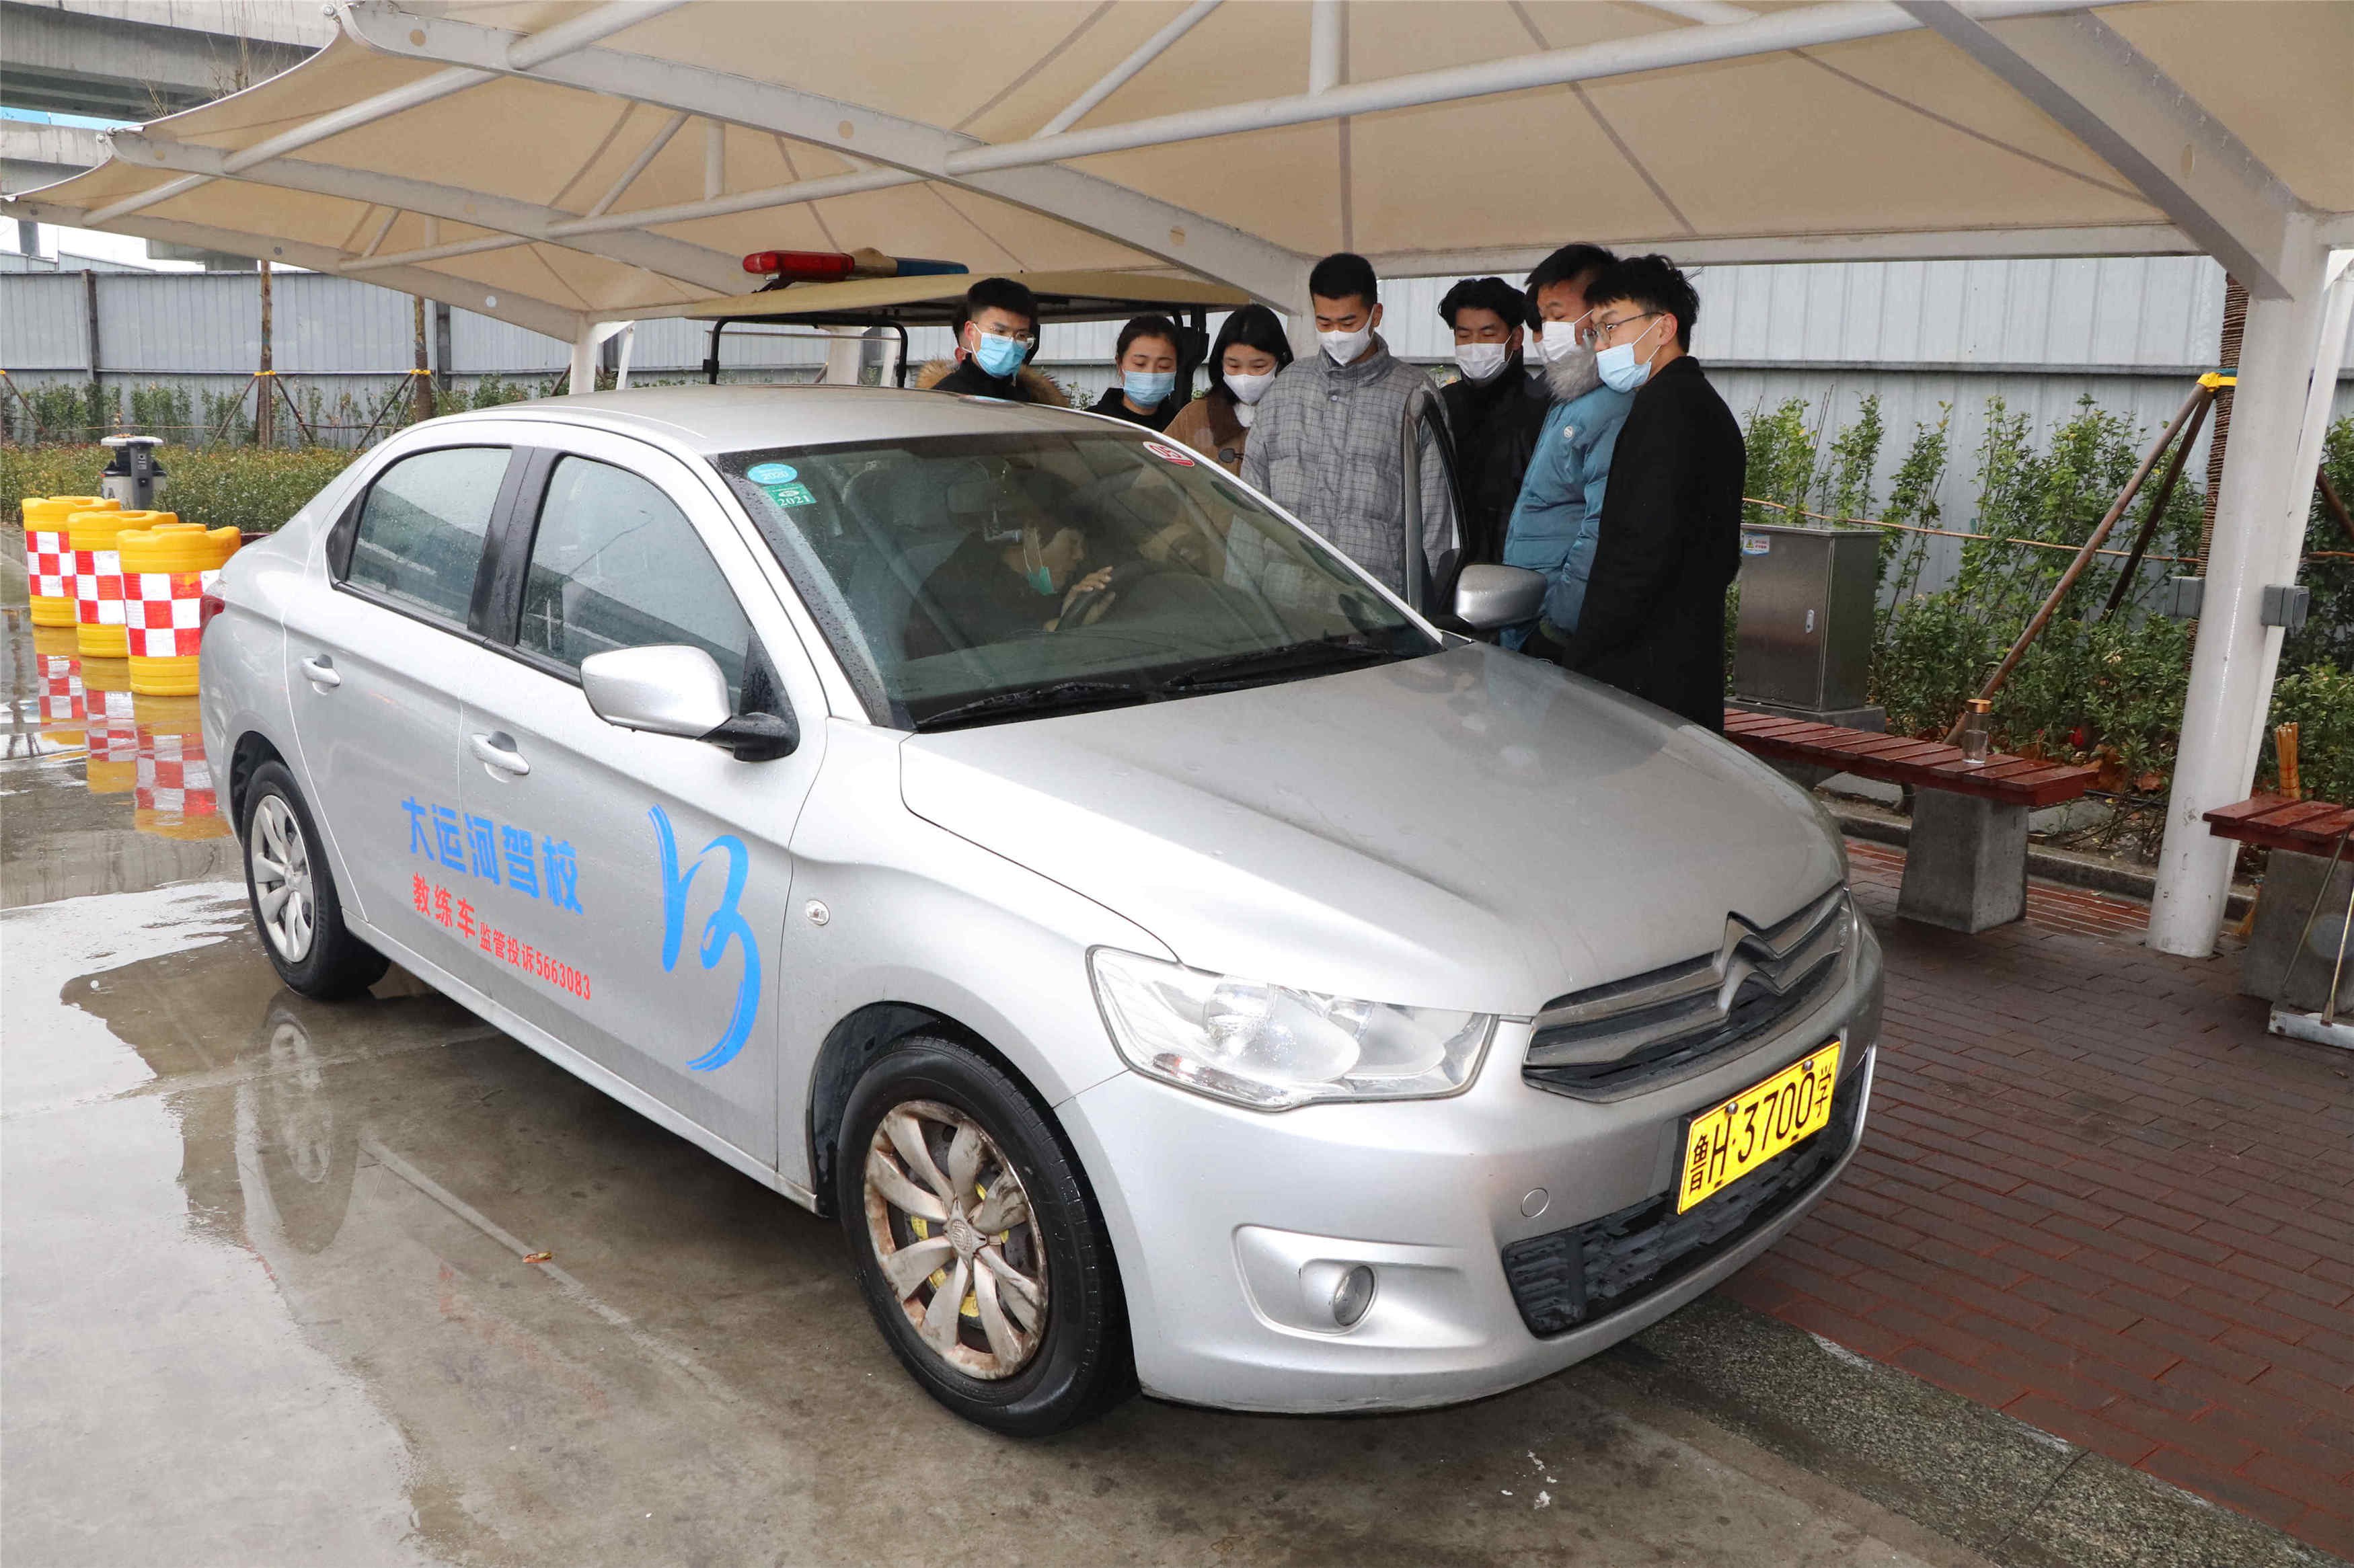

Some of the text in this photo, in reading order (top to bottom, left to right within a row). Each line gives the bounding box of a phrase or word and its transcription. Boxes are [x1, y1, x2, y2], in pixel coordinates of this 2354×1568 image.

[778, 495, 810, 506] 2021
[402, 796, 583, 915] 大运河驾校
[412, 873, 591, 1001] 教练车 监管投诉5663083
